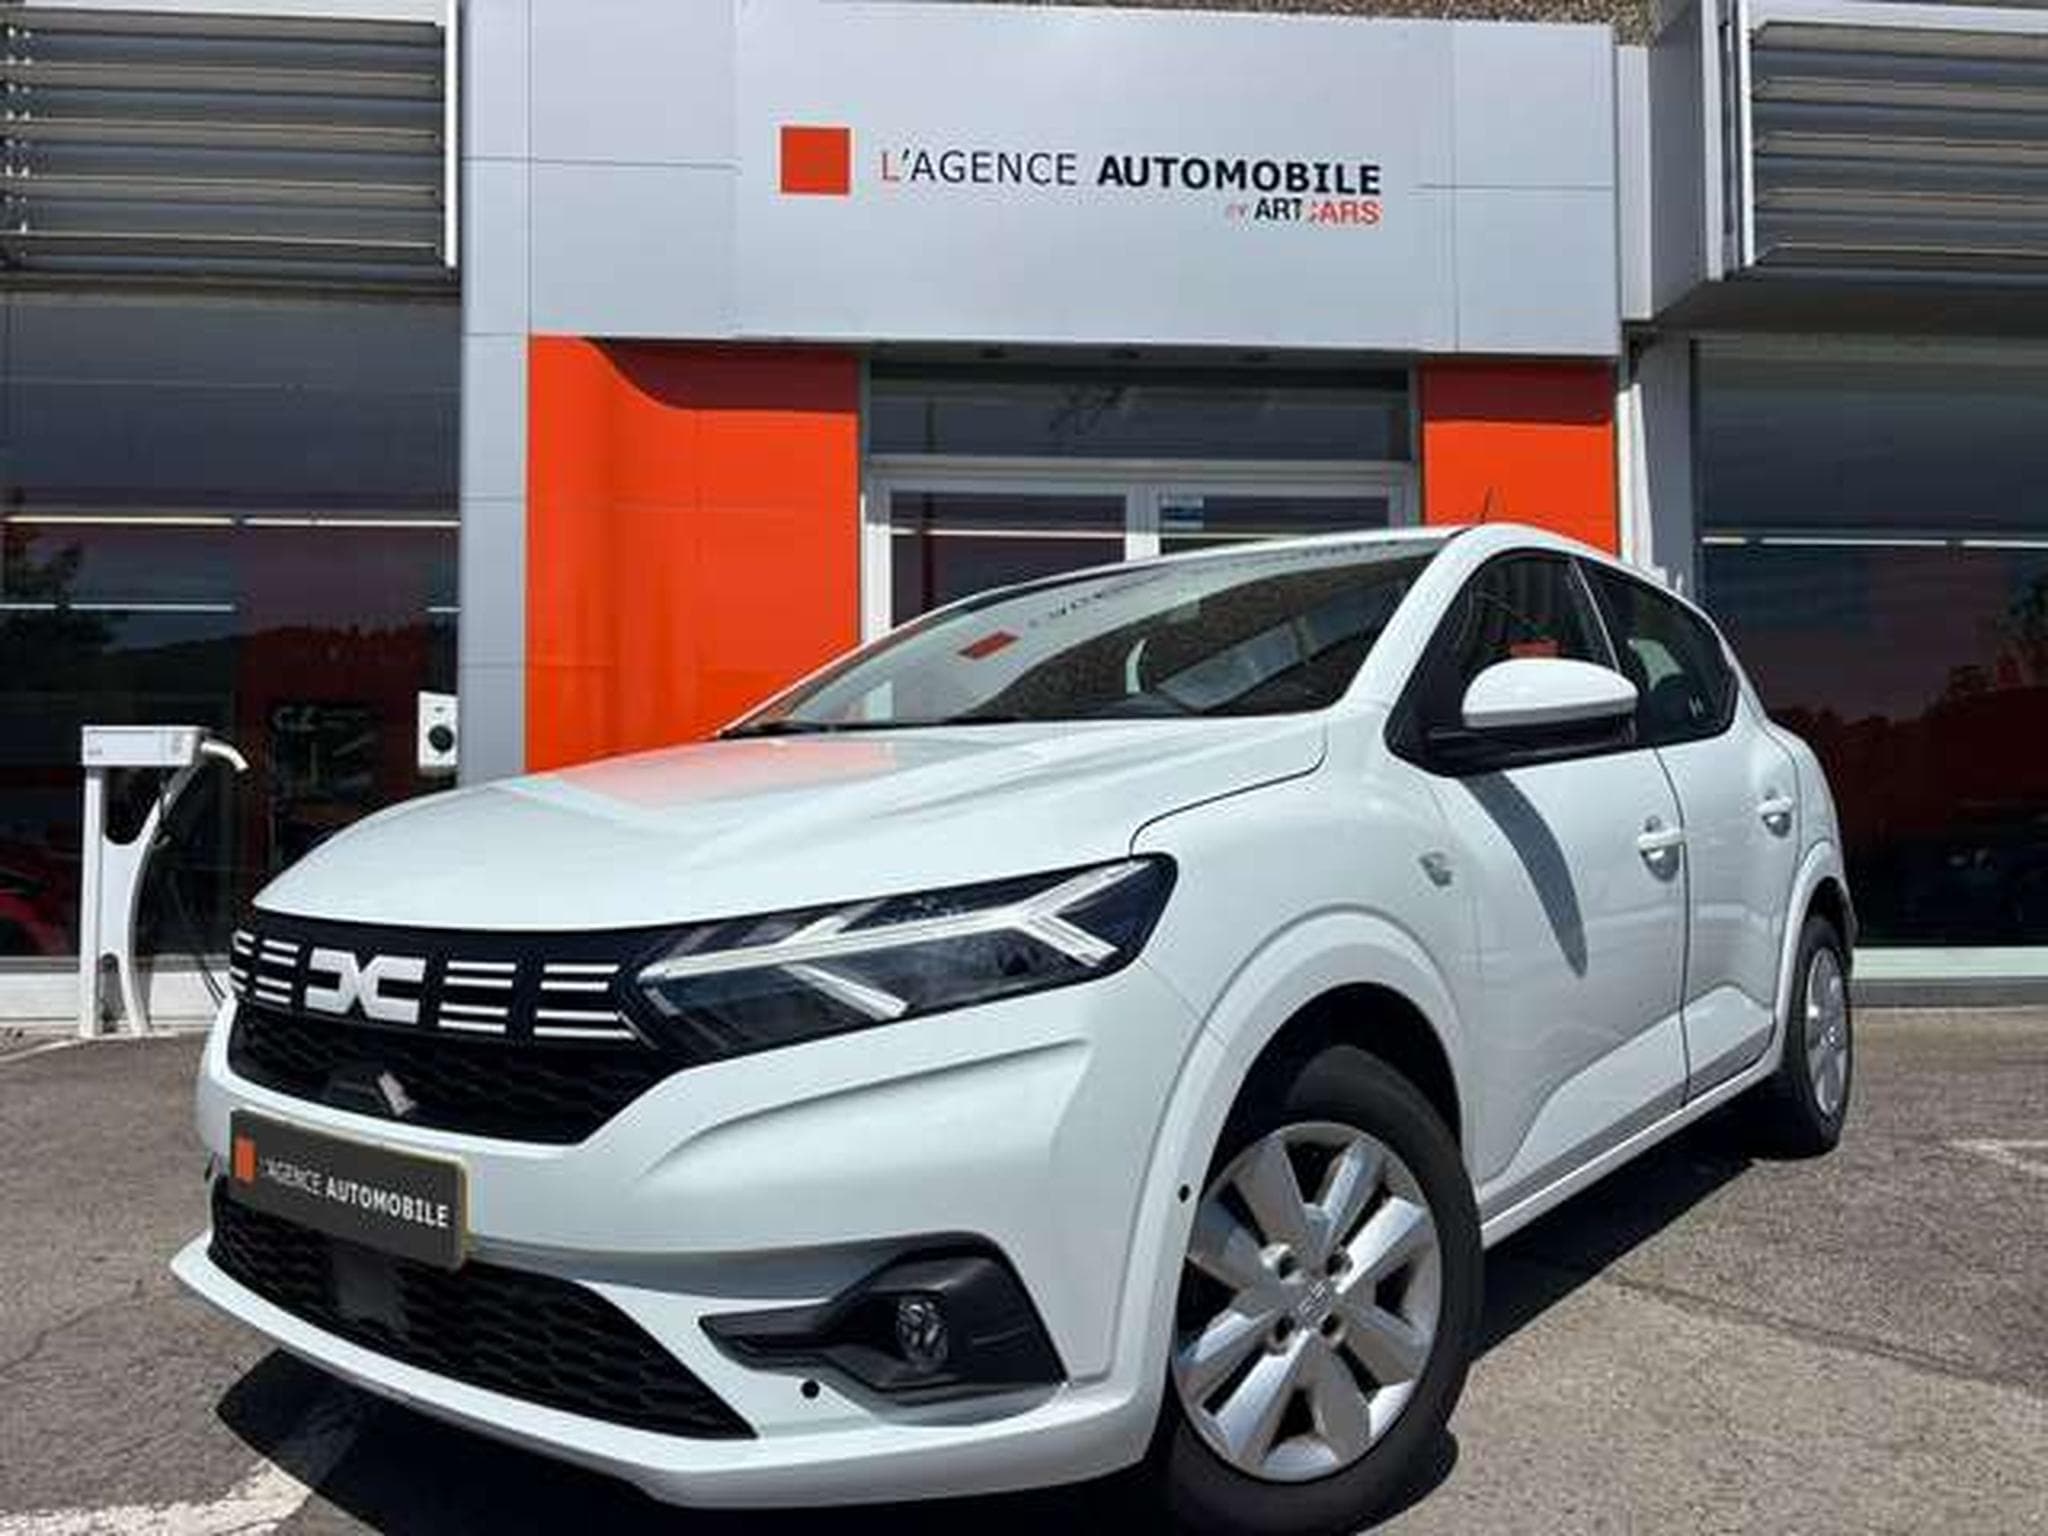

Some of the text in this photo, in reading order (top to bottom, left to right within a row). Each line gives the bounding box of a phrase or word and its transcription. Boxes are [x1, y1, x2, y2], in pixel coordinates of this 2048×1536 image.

[881, 149, 1381, 196] L'AGENCE AUTOMOBILE
[259, 1158, 449, 1227] 'AGENCE AUTOMOBILE
